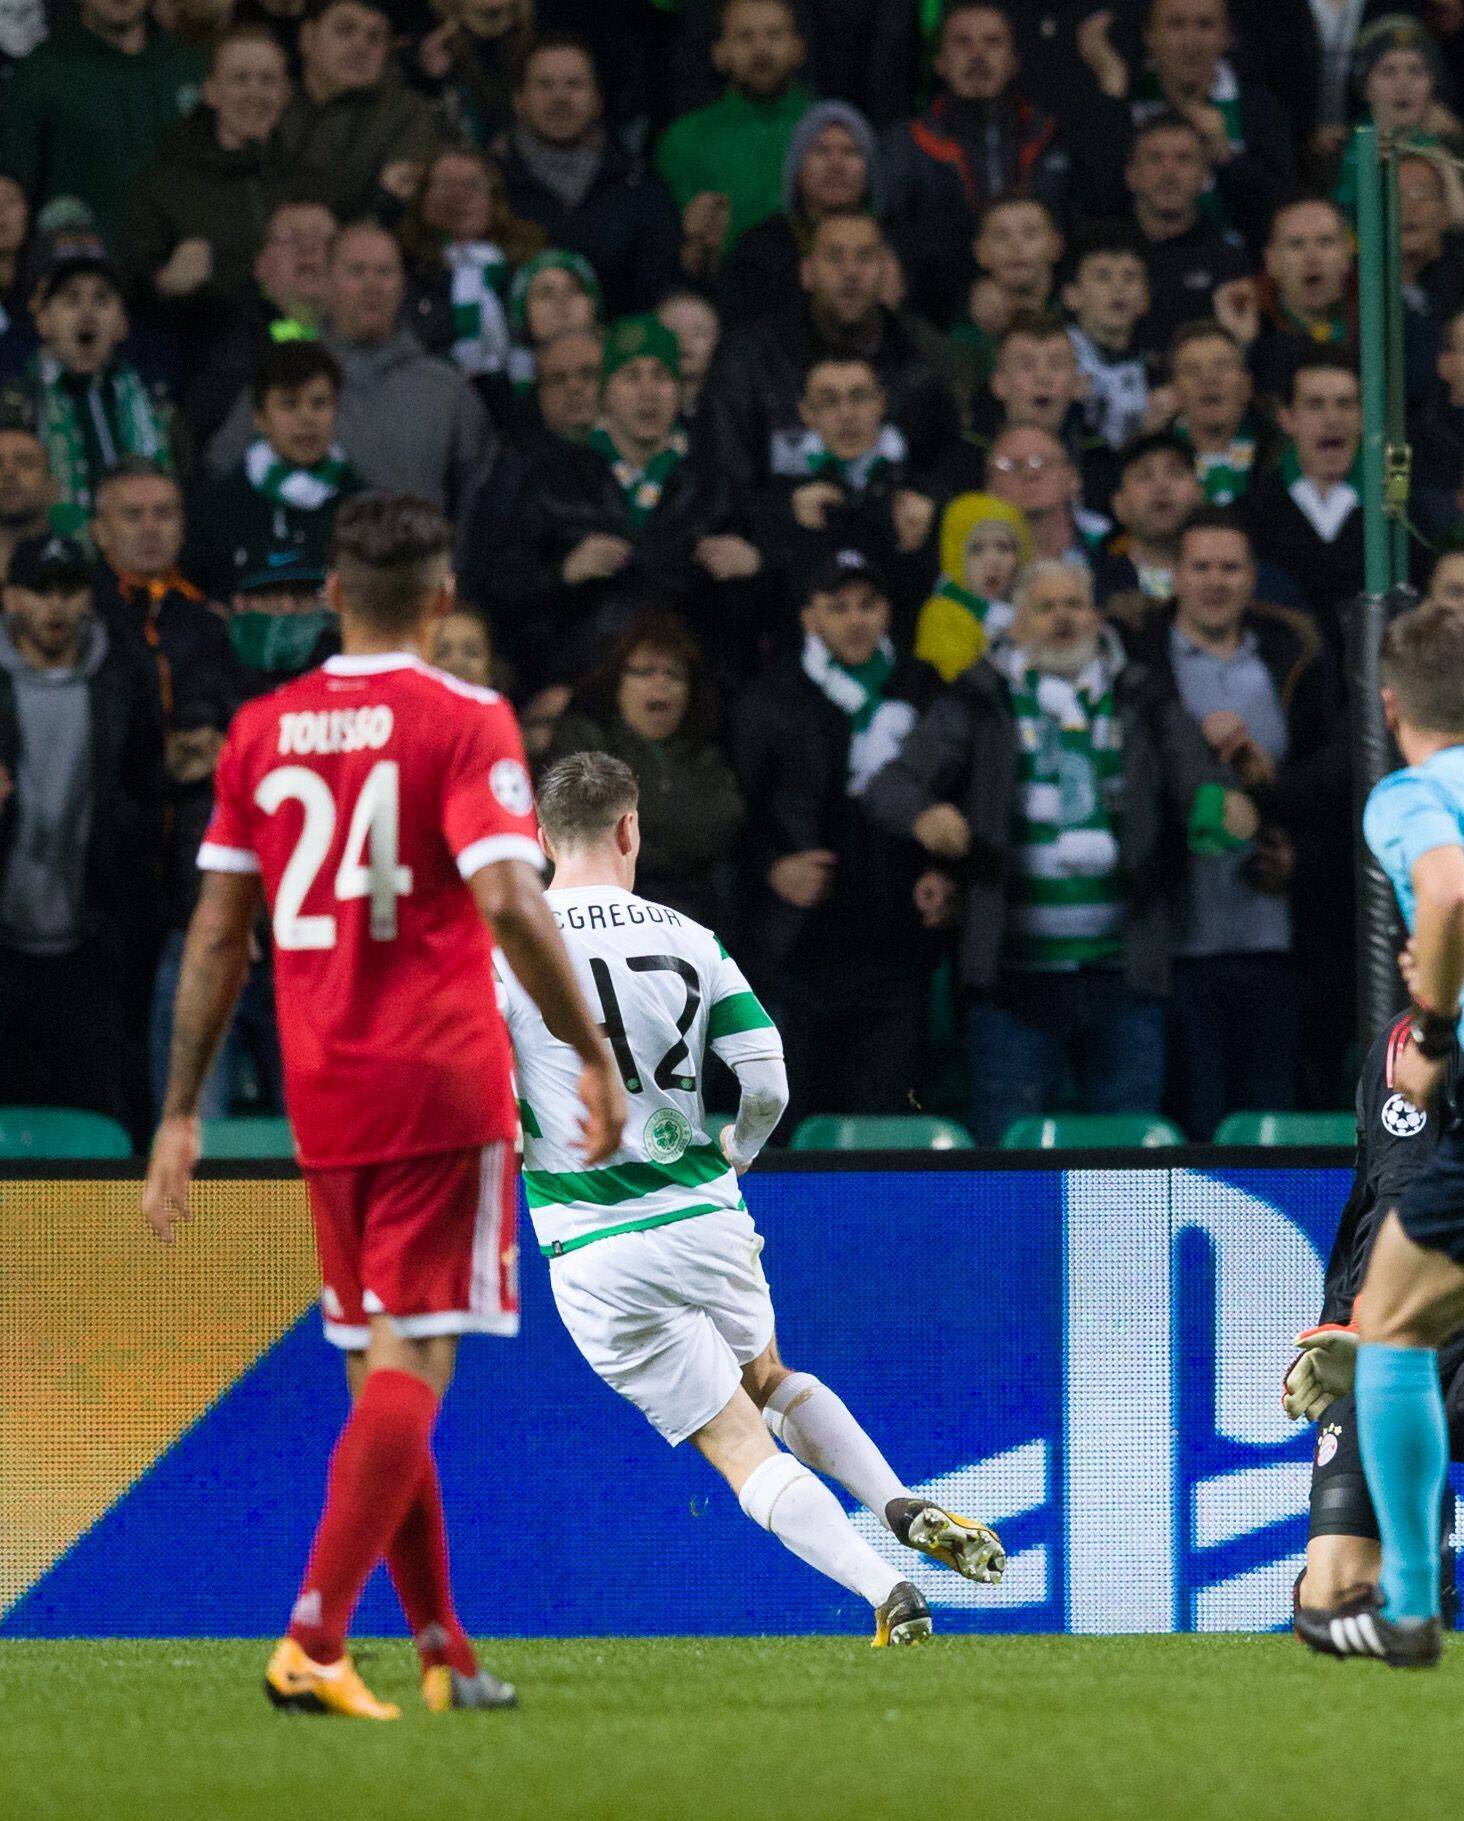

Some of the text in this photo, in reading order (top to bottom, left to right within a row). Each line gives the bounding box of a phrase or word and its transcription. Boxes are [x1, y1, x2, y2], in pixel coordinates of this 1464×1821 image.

[278, 704, 394, 756] TOLISSO
[254, 763, 414, 950] 24
[552, 904, 681, 930] GREGOR
